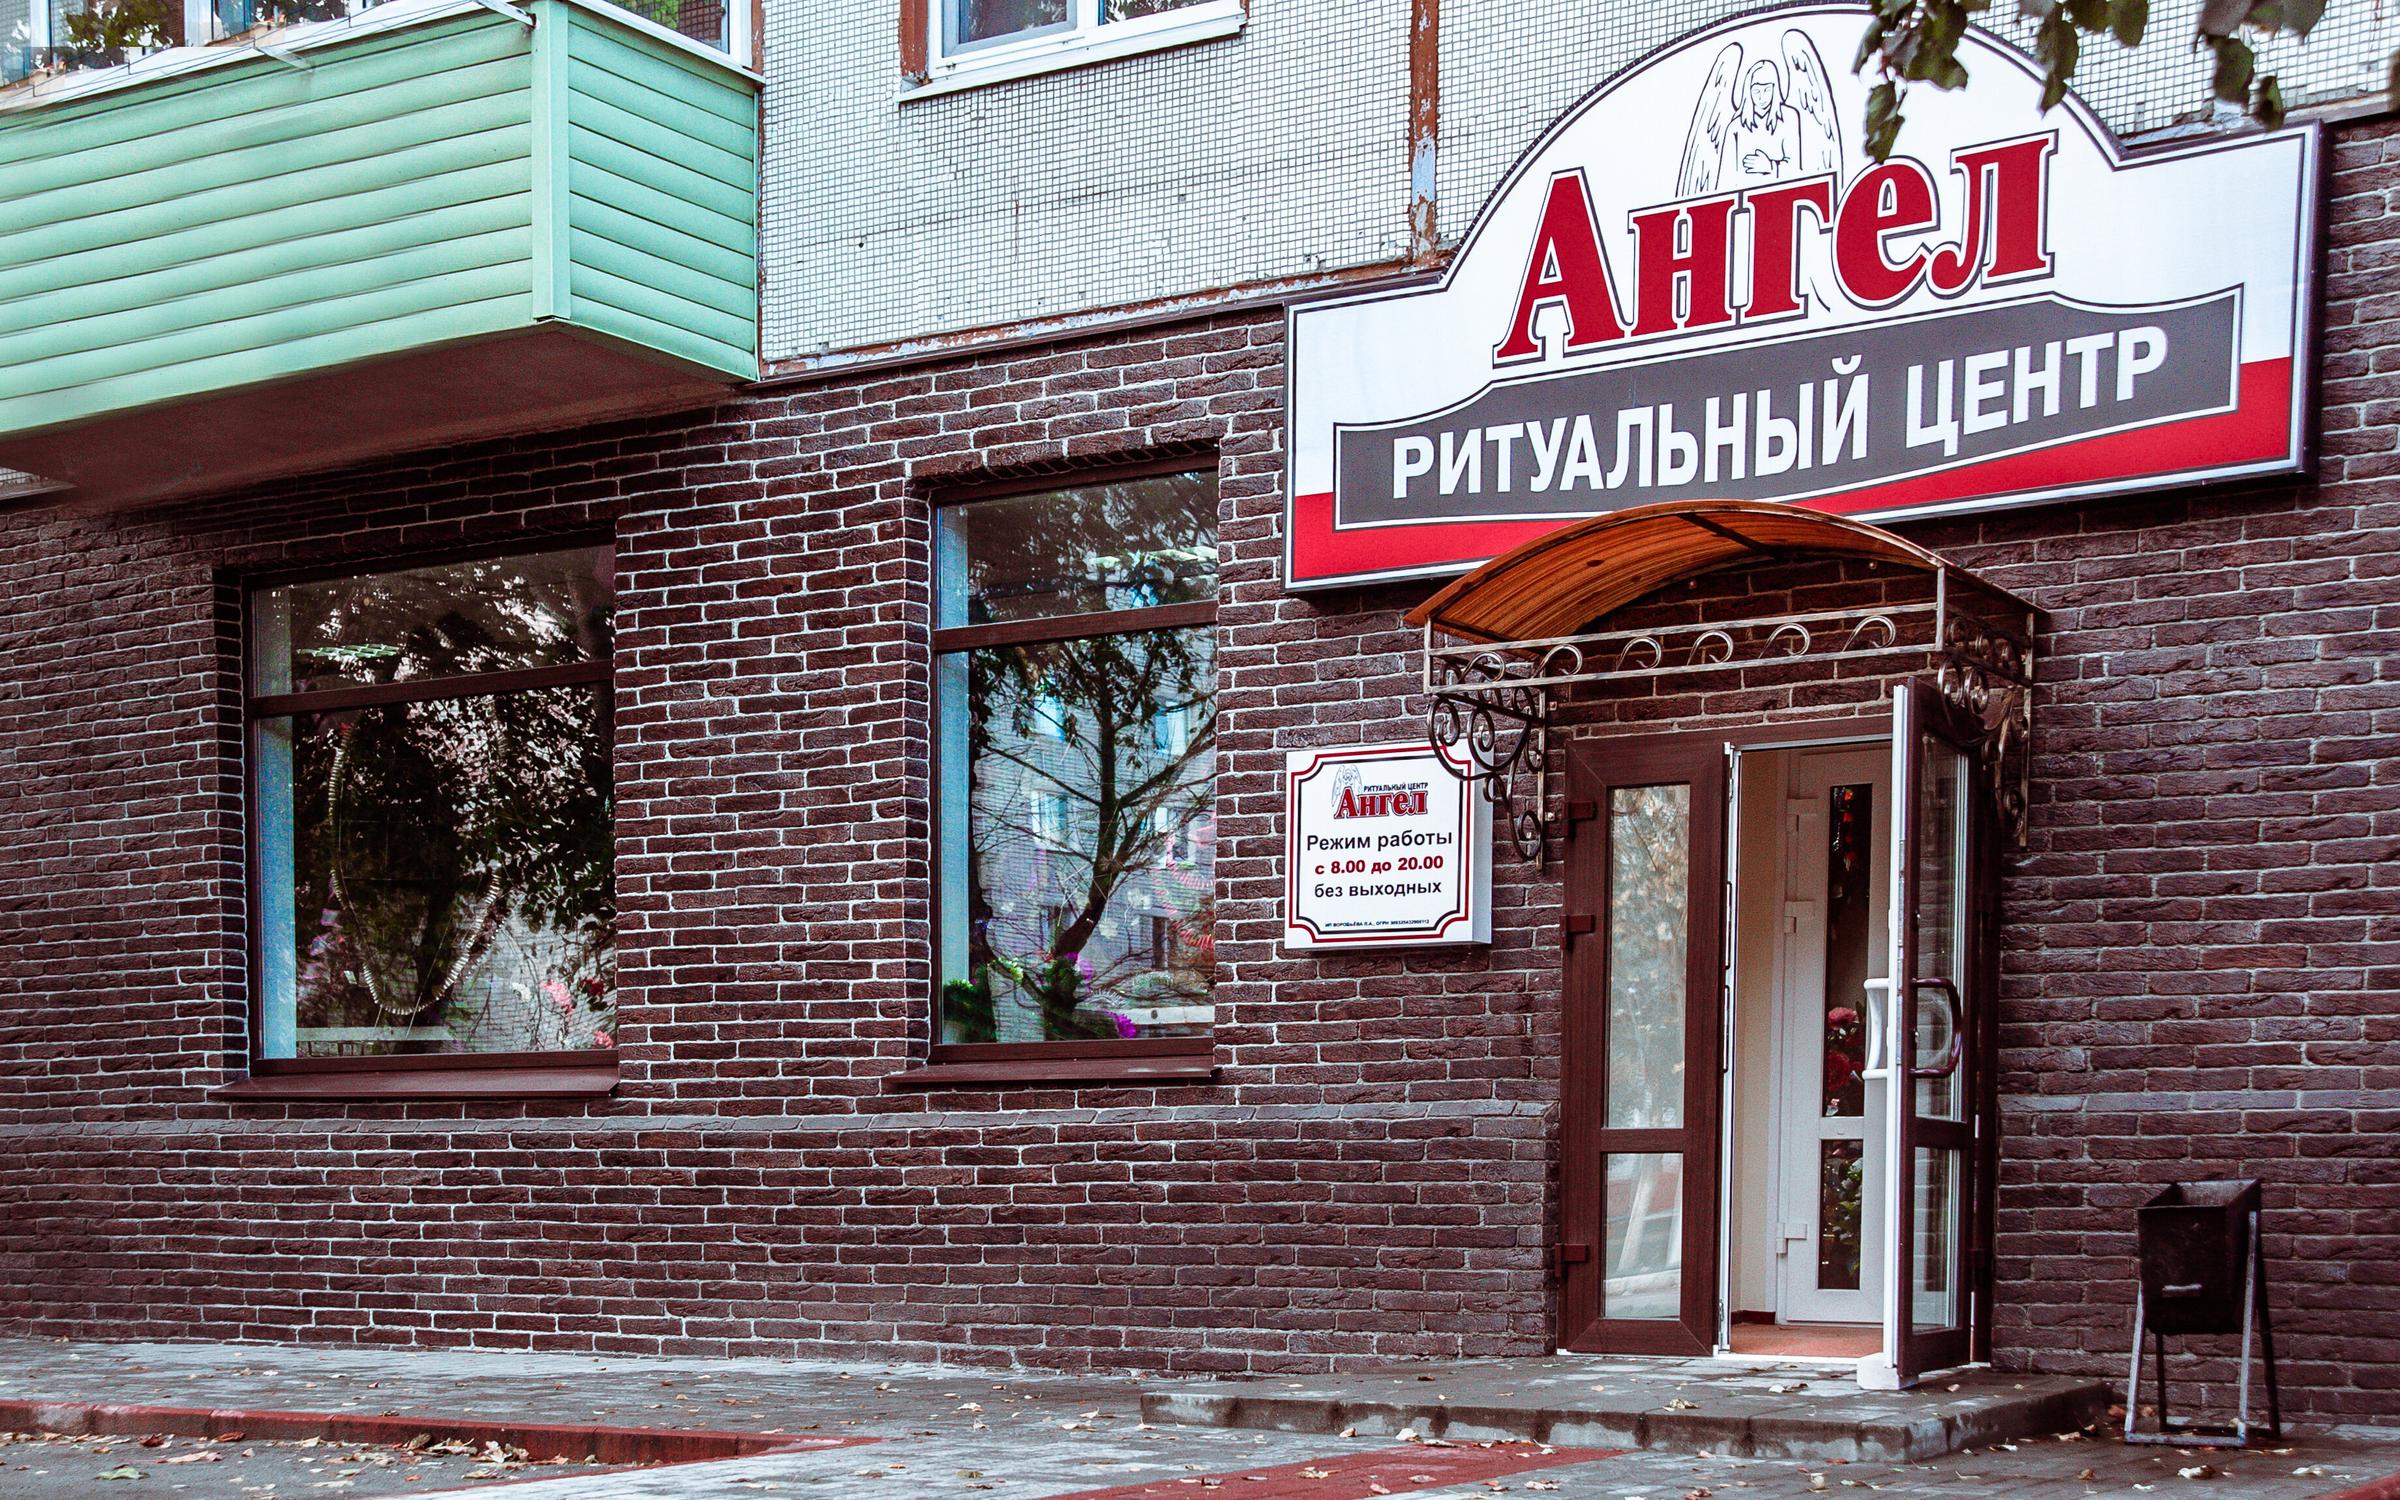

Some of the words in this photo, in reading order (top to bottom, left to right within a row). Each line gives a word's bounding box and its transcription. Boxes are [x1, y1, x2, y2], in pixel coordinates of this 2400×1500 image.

[1493, 129, 2058, 368] Ангел
[1393, 354, 1869, 499] РИТУАЛЬНЫЙ
[1906, 326, 2168, 457] ЦЕНТР
[1363, 781, 1406, 793] РИТУАЛЬНЫЙ
[1407, 782, 1429, 791] ЦЕНТР
[1334, 786, 1428, 819] Ангел
[1307, 835, 1371, 851] Режим
[1378, 830, 1452, 852] работы
[1315, 864, 1325, 875] с
[1331, 860, 1366, 875] 8.00
[1371, 861, 1392, 875] до
[1398, 855, 1444, 871] 20.00
[1314, 883, 1343, 898] без
[1349, 881, 1442, 897] выходных
